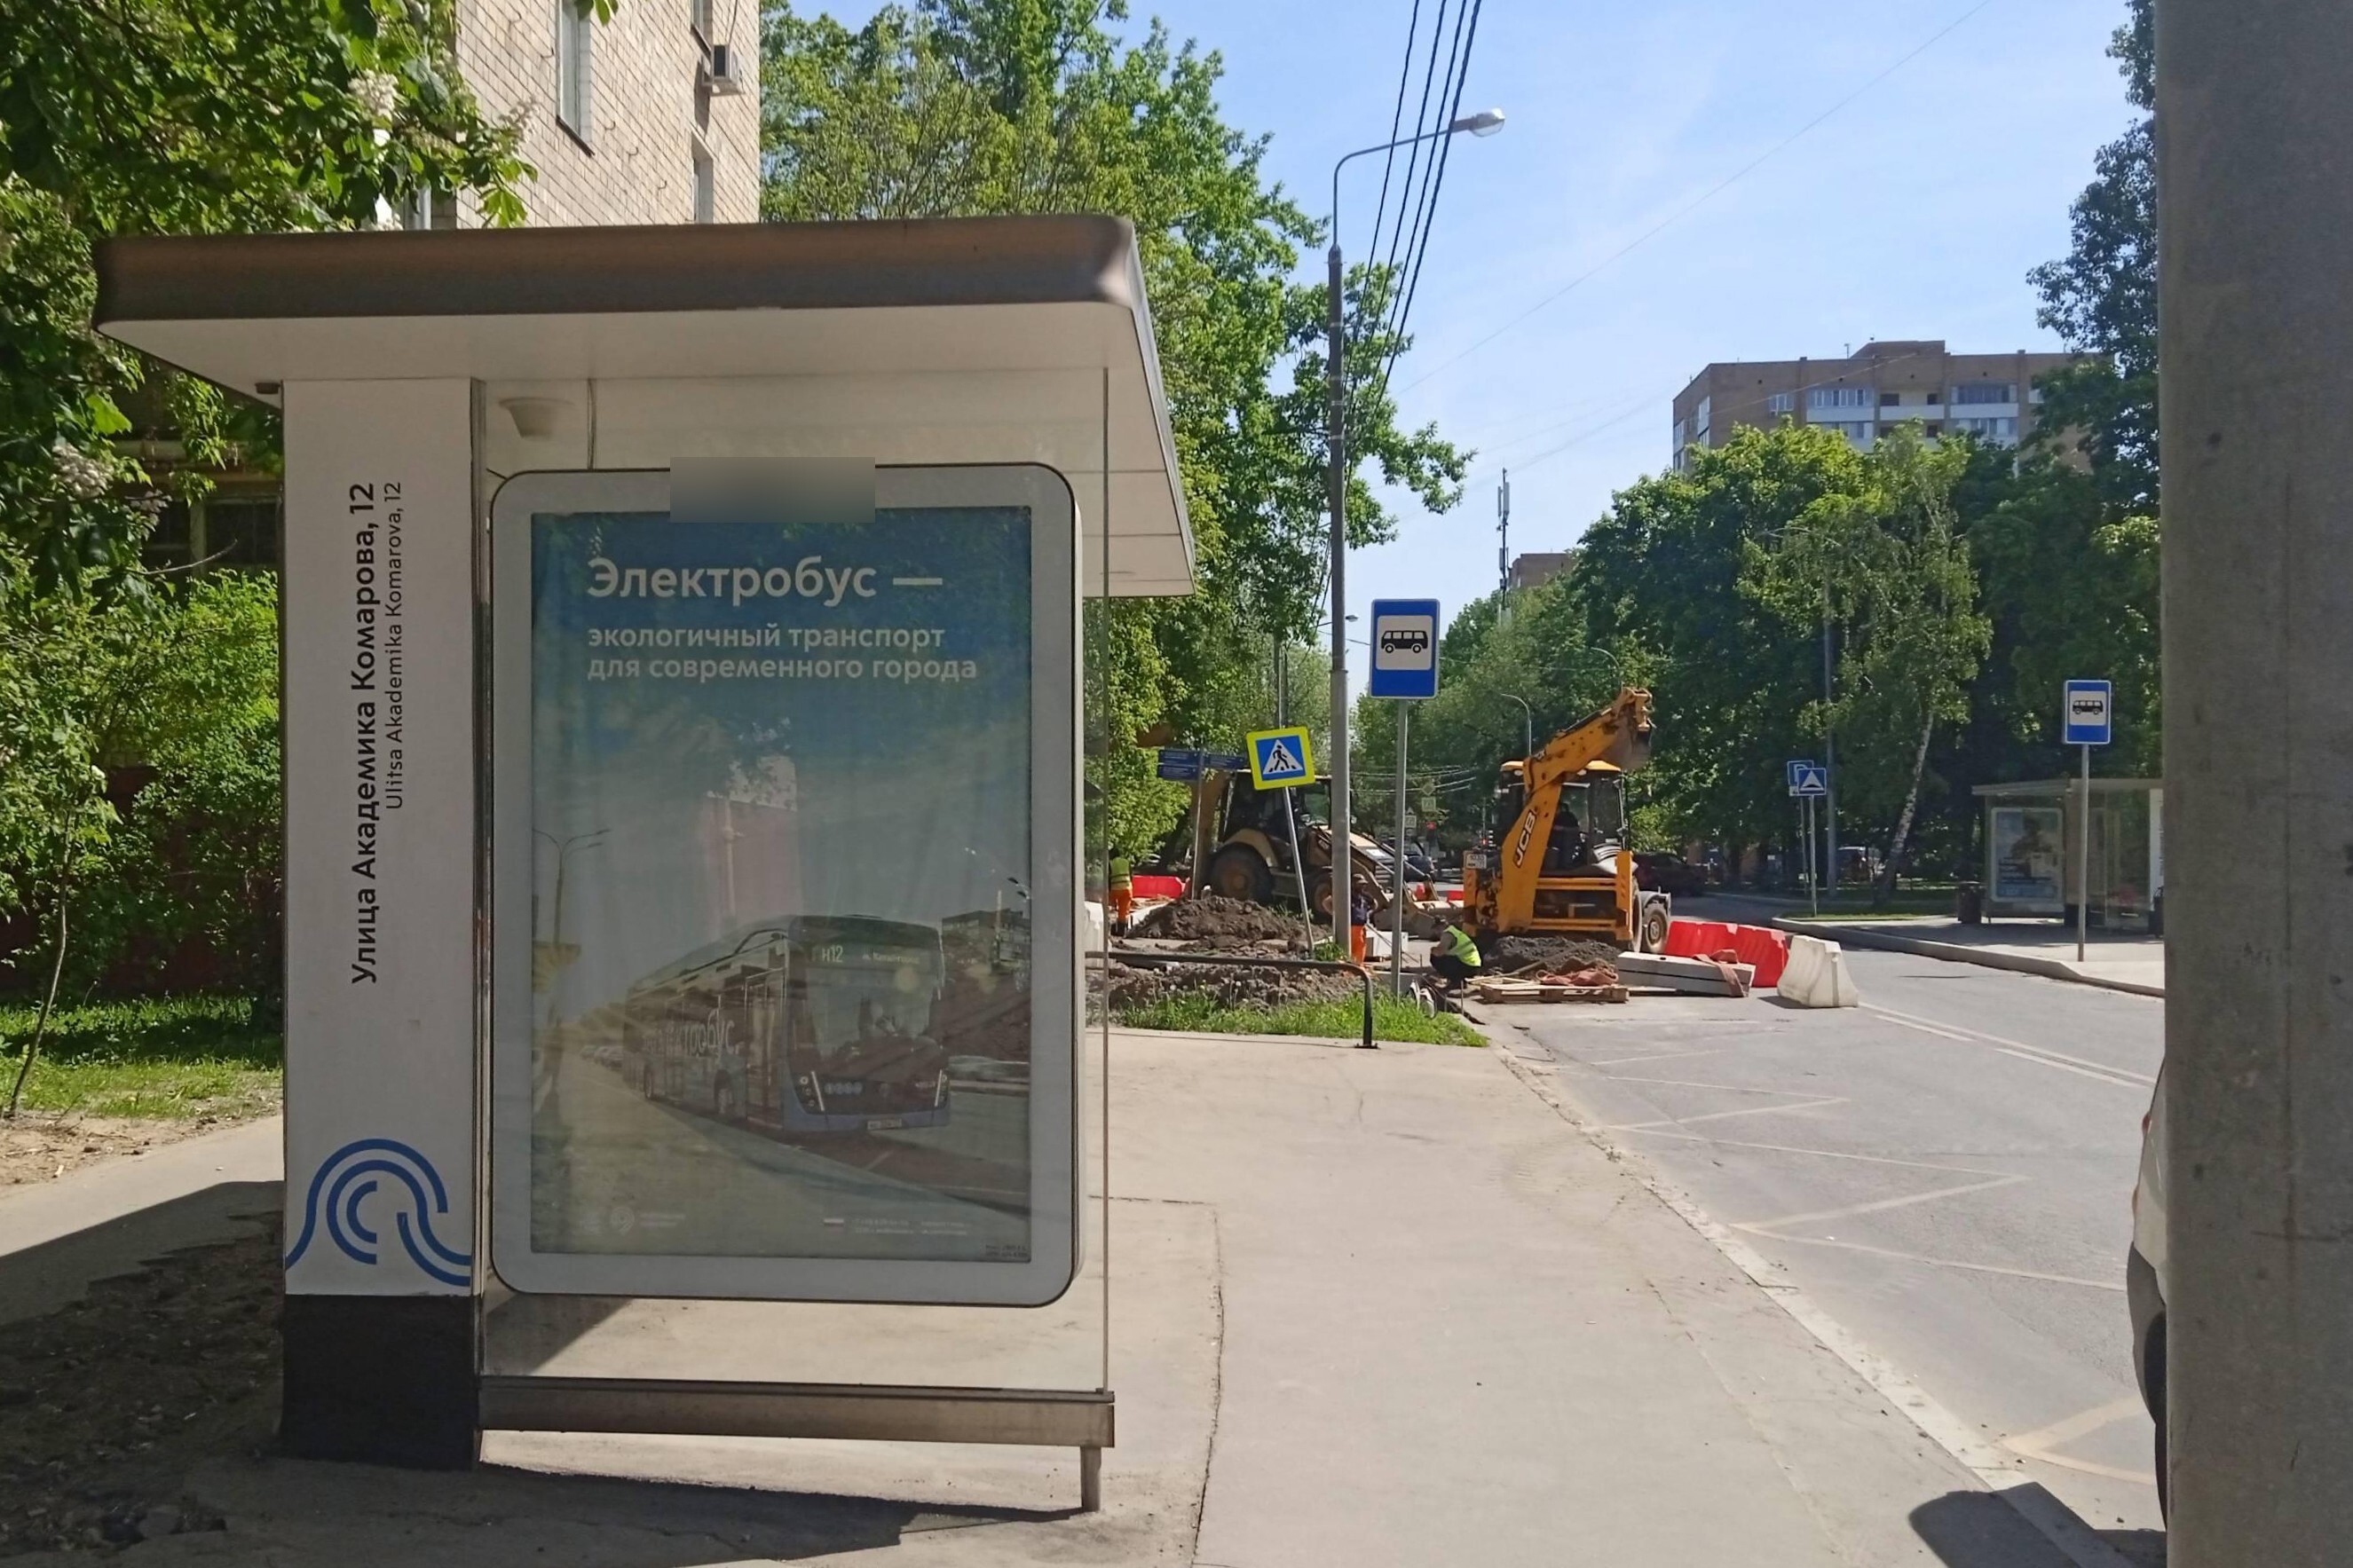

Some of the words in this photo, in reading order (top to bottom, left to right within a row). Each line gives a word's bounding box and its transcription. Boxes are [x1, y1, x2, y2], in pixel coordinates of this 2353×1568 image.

[349, 482, 375, 515] 12
[383, 482, 401, 502] 12
[384, 508, 404, 616] Komarova,
[587, 555, 877, 606] Электробус
[350, 522, 381, 689] Комарова,
[588, 623, 780, 648] экологичный
[788, 627, 944, 654] транспорт
[383, 624, 403, 743] Akademika
[588, 658, 640, 682] для
[649, 656, 865, 683] современного
[873, 656, 977, 684] города
[351, 701, 381, 879] Академика
[384, 749, 403, 808] Ulitsa
[1515, 810, 1536, 867] JCB
[351, 888, 381, 983] Улица
